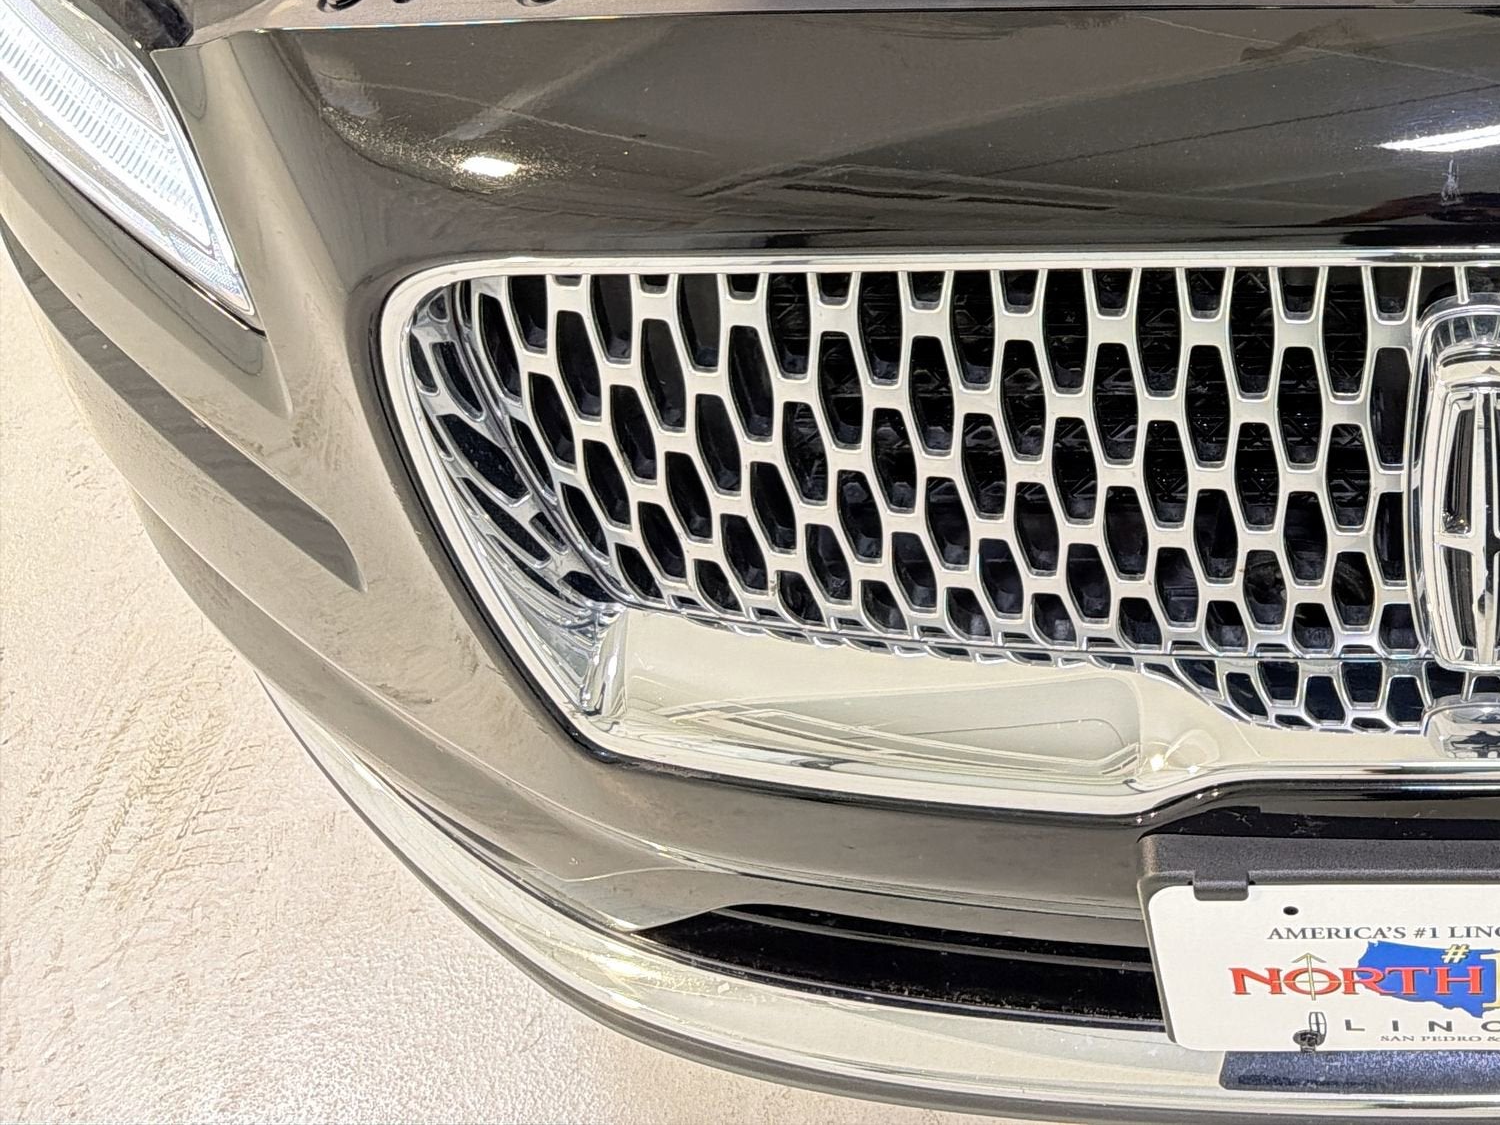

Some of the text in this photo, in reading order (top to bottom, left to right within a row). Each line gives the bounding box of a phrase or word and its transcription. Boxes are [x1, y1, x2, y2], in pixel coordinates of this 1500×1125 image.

[1266, 925, 1407, 941] AMERICA'S
[1413, 925, 1441, 940] #1
[1227, 966, 1484, 996] NORTH
[1379, 1034, 1415, 1043] SAN
[1420, 1034, 1483, 1043] PEDRO
